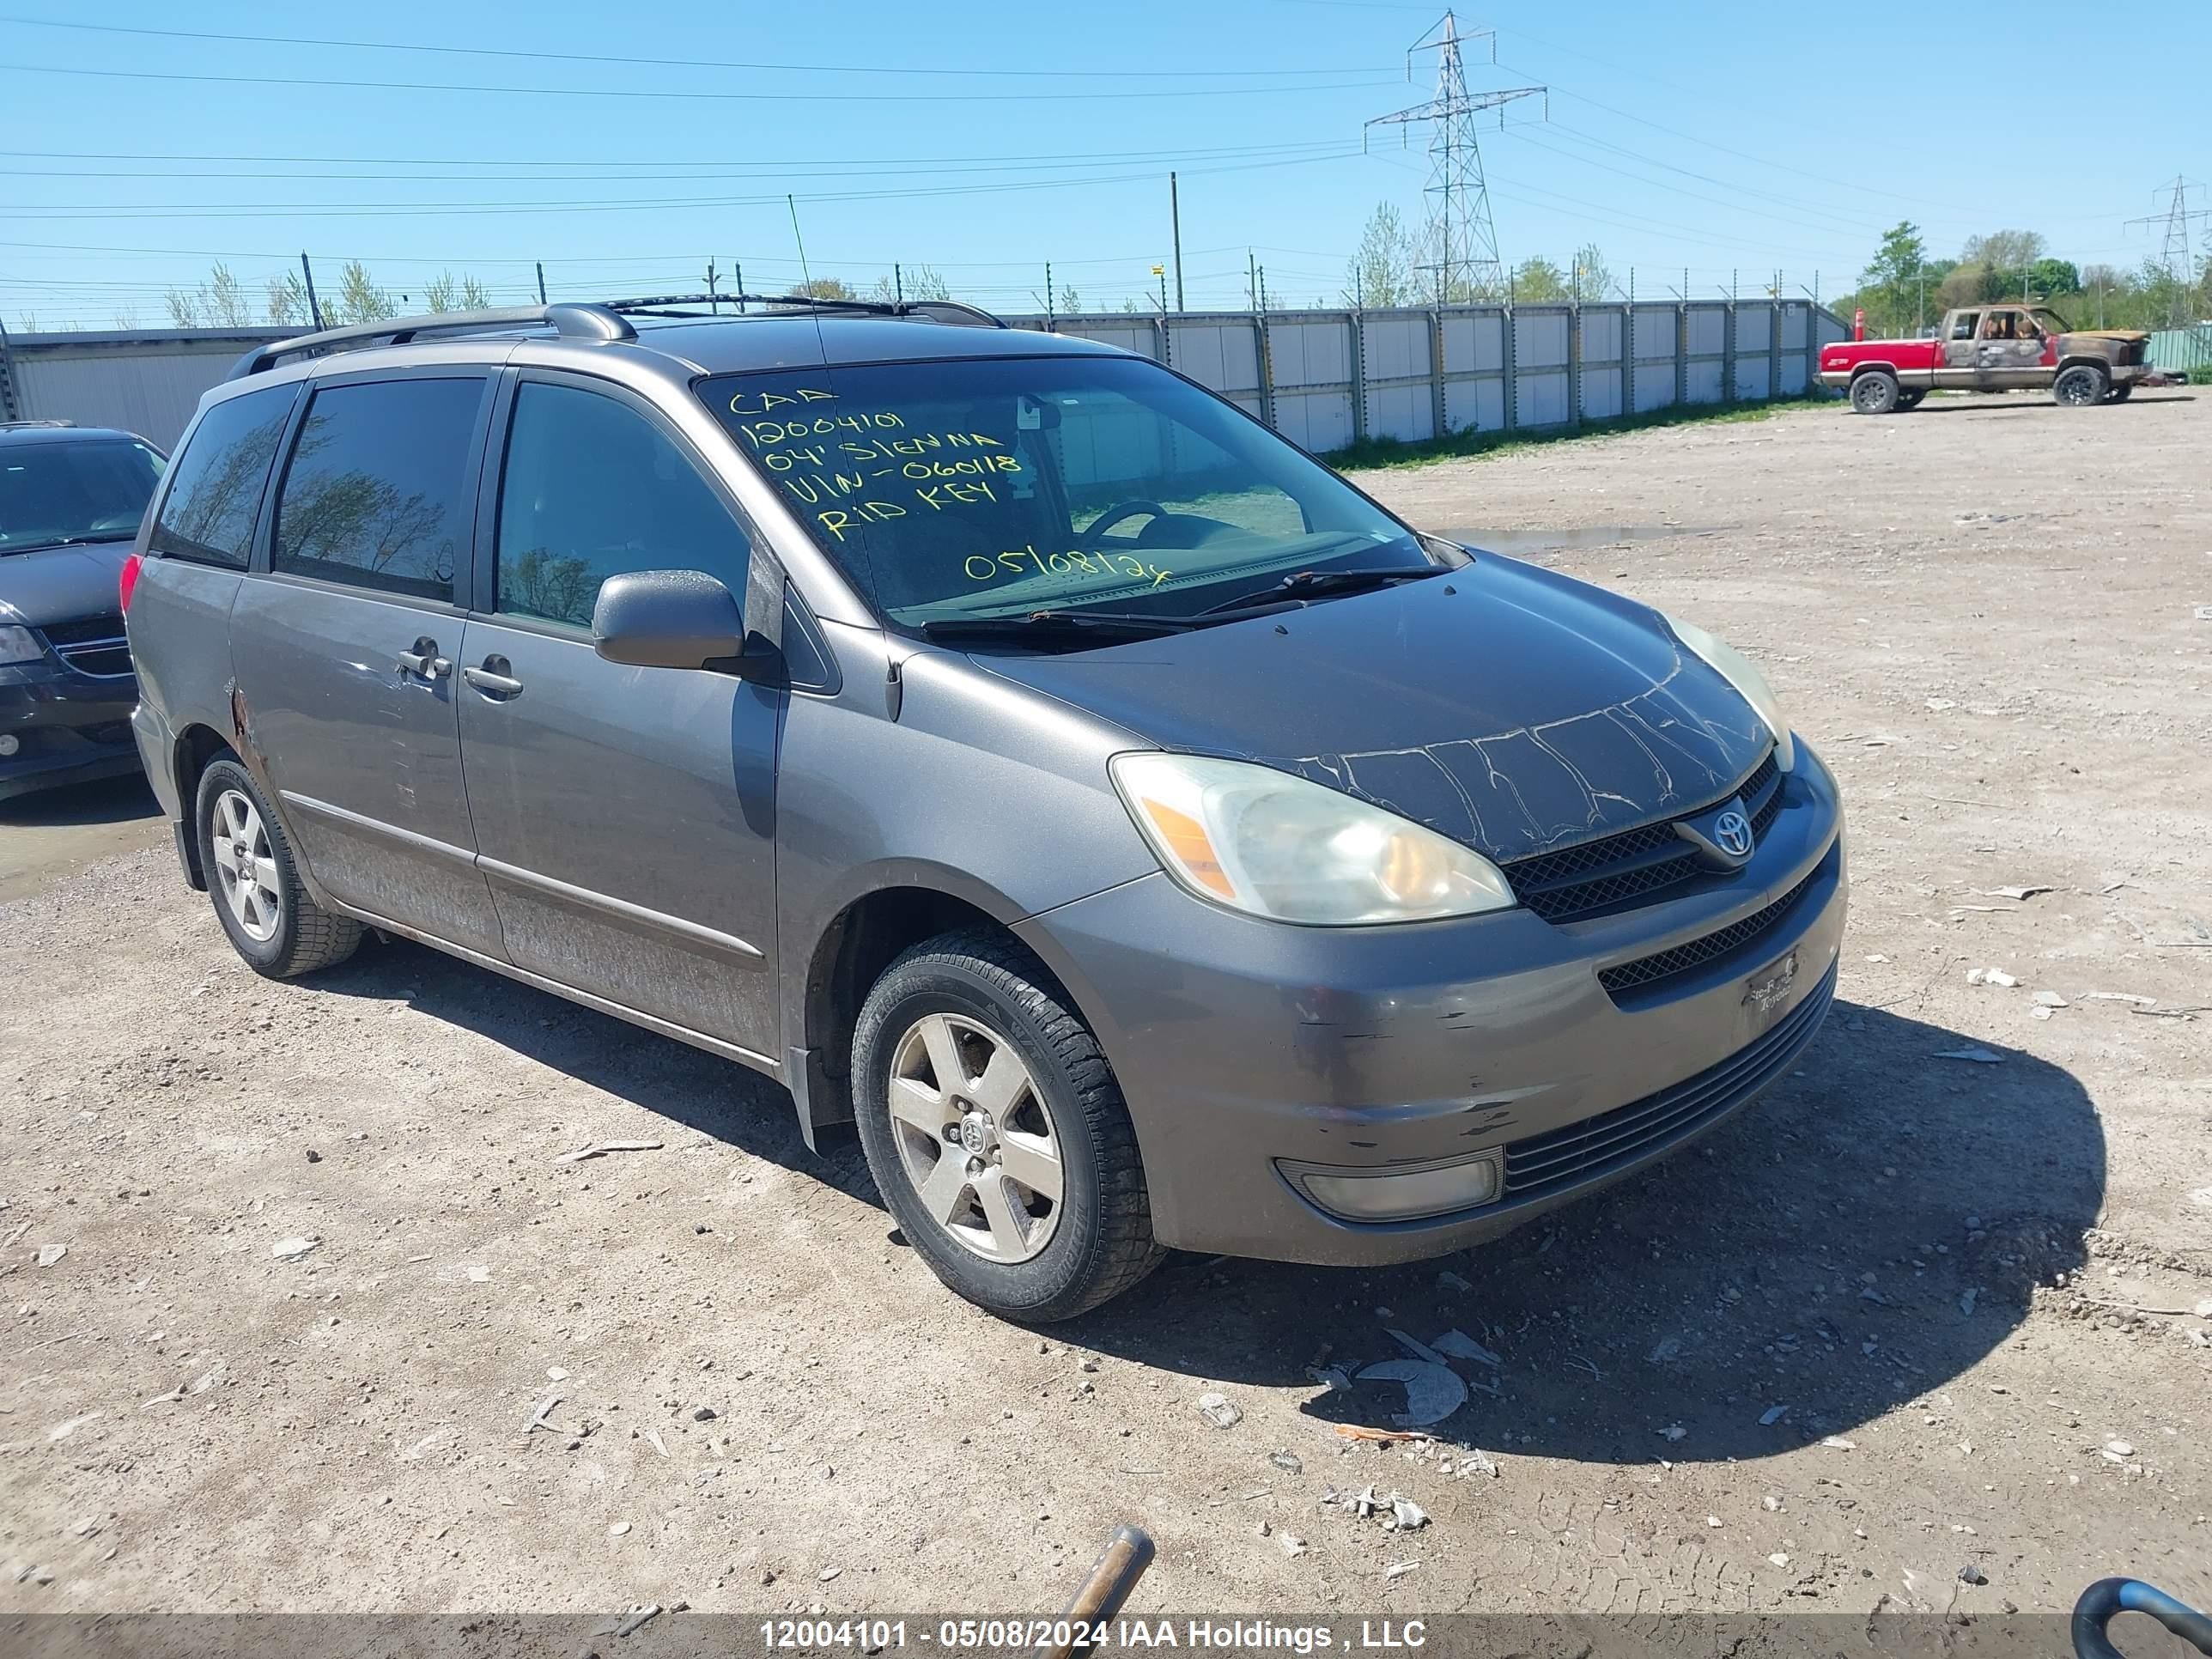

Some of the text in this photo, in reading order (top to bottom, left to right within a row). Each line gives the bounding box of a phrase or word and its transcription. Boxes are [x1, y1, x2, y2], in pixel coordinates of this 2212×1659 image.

[740, 412, 905, 449] 12004101
[838, 433, 1005, 461] SIENNA
[916, 481, 997, 511] KEY
